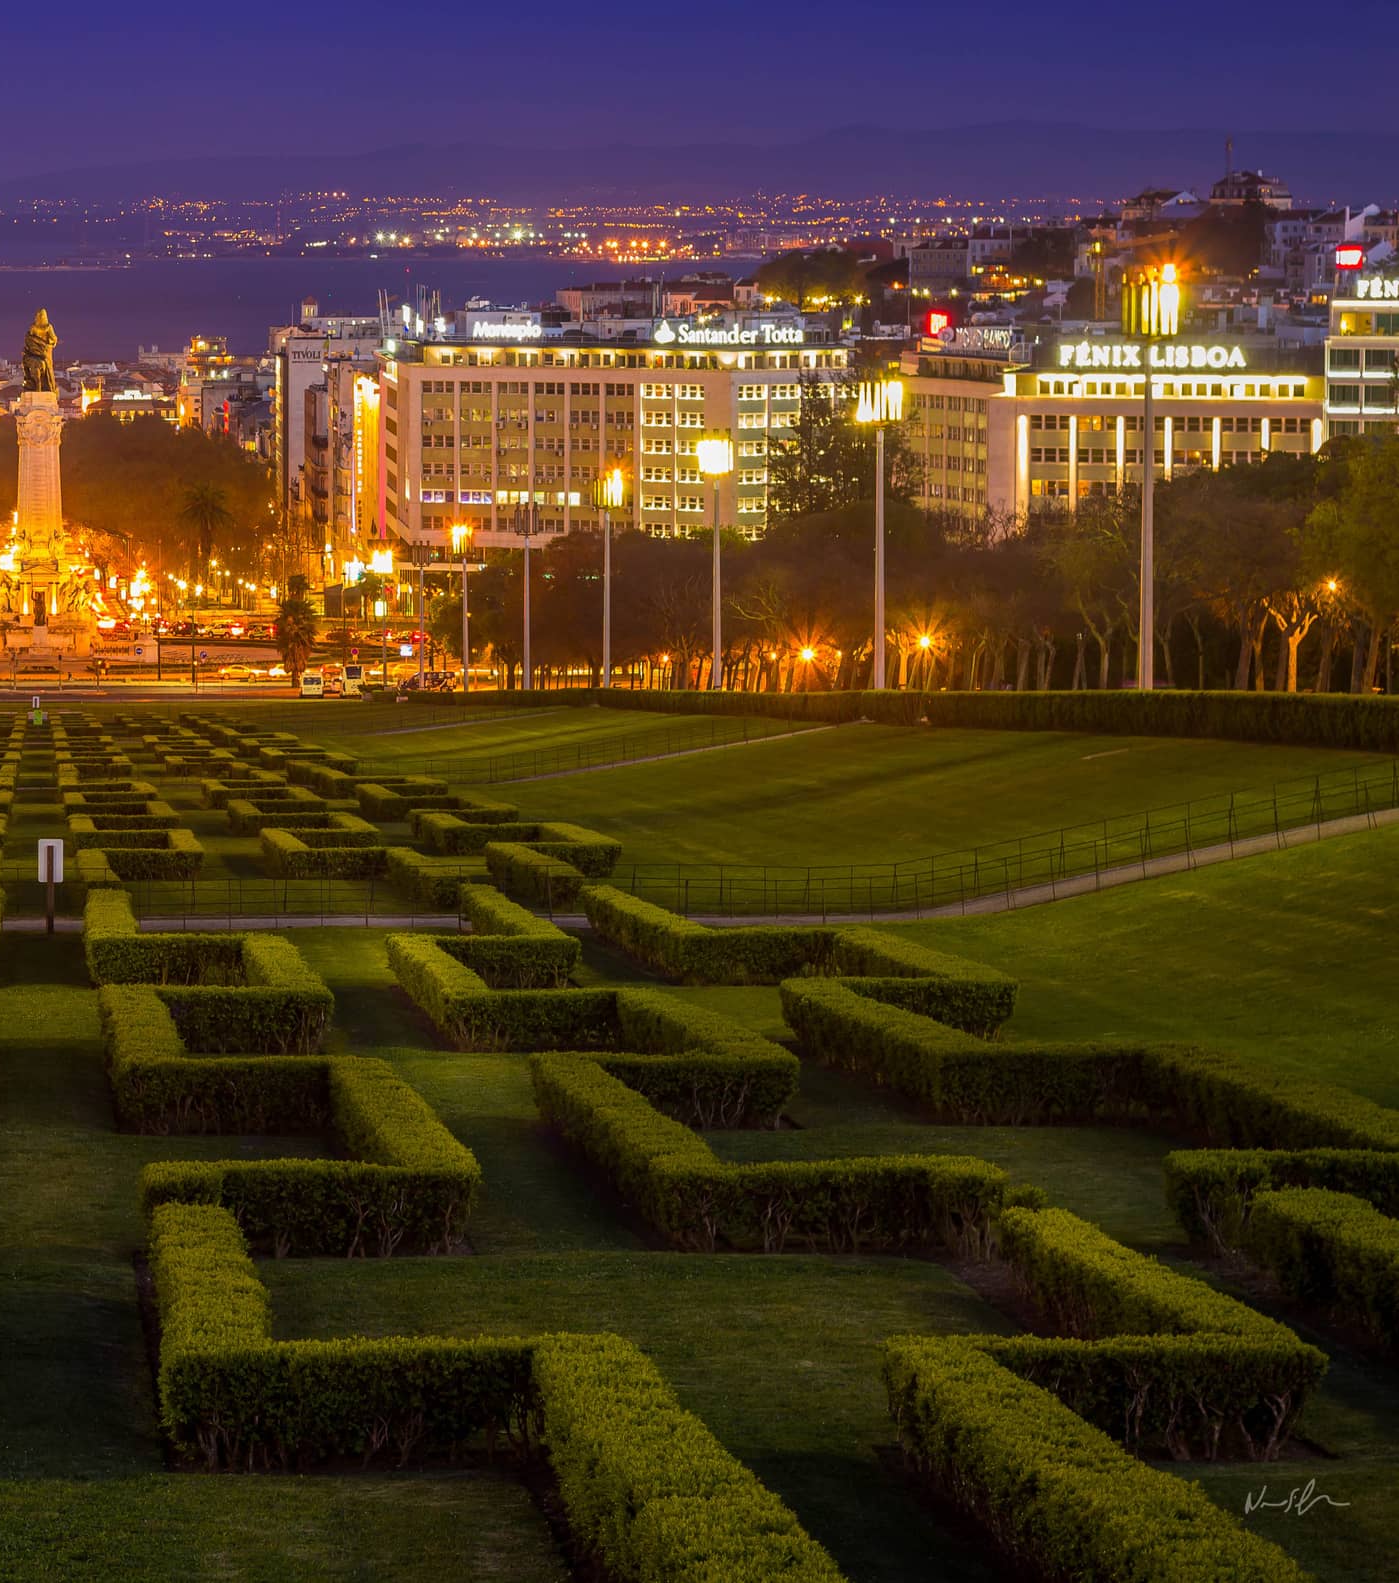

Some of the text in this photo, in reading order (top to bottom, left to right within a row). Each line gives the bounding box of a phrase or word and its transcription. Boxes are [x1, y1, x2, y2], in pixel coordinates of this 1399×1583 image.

[472, 321, 542, 341] Montepio
[678, 323, 803, 344] Santander Totta
[291, 346, 321, 360] TIVOLI
[1059, 340, 1247, 367] FÉNIX LISBOA
